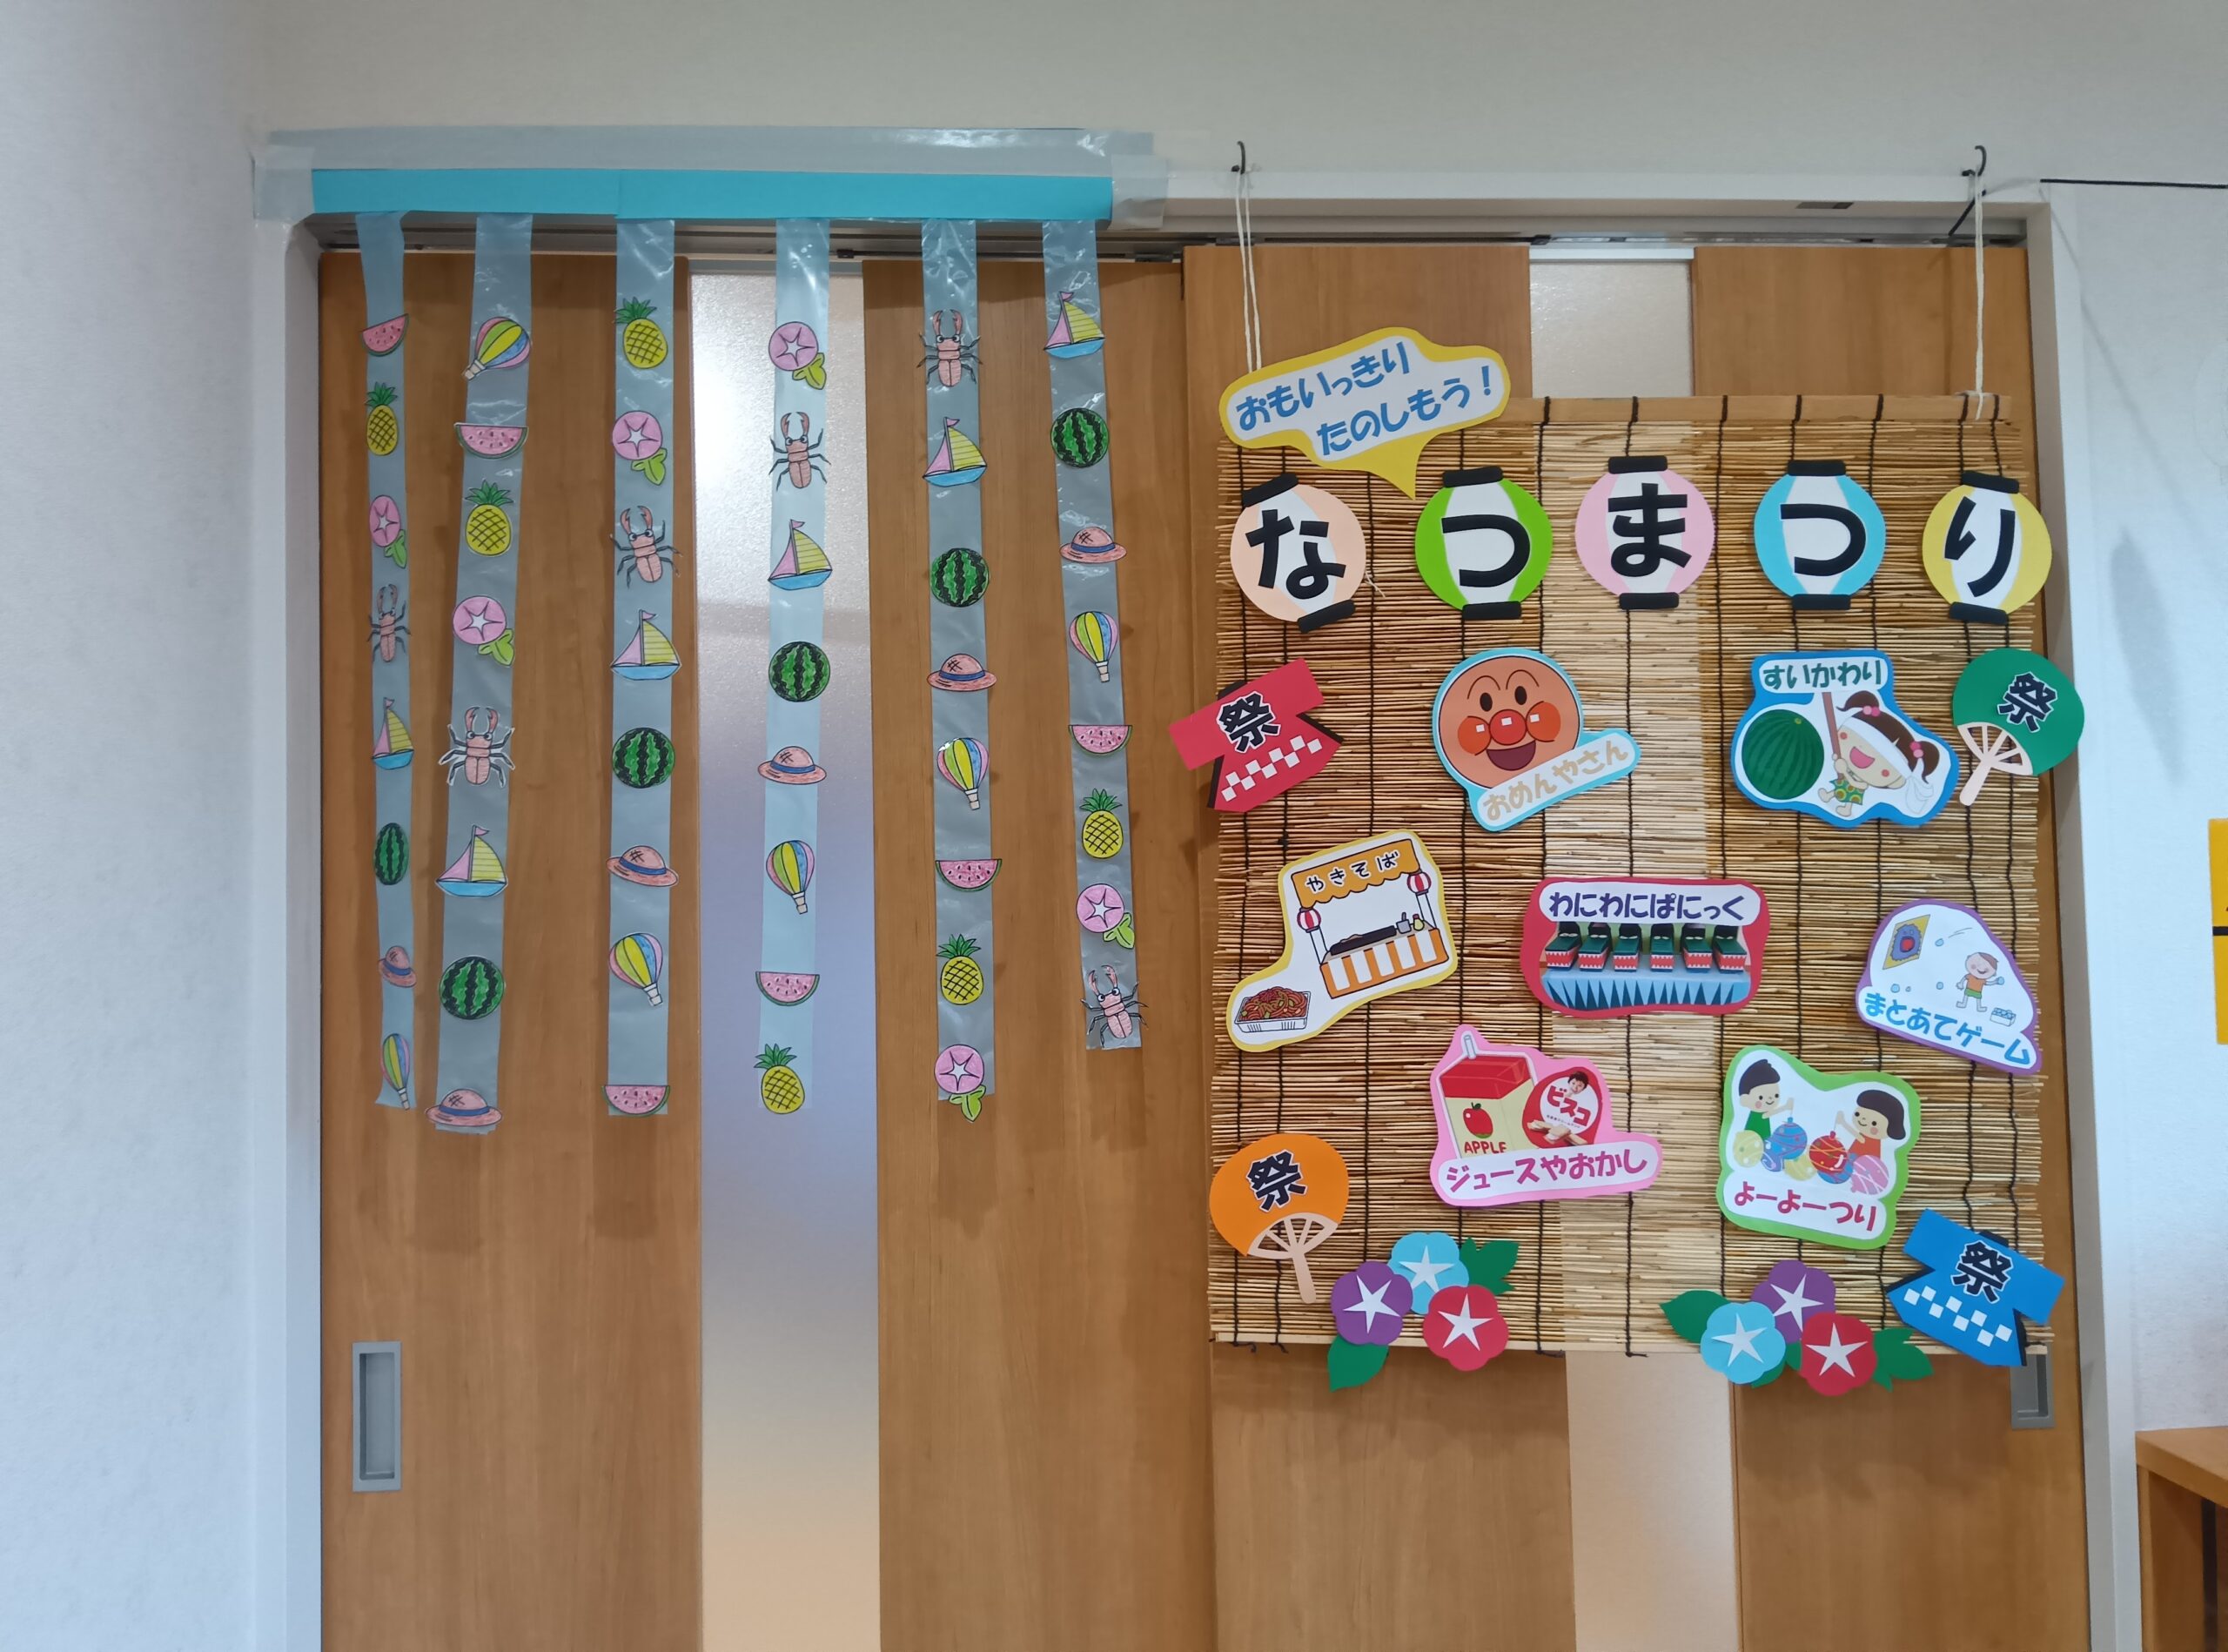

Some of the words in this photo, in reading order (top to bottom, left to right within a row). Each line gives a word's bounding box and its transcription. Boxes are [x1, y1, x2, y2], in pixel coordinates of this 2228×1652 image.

[1235, 341, 1410, 432] おもいっきり
[1763, 658, 1883, 690] すいかわり
[1996, 672, 2057, 732] 祭
[1218, 691, 1281, 753] 祭
[1482, 740, 1628, 821] おめんやさん
[1305, 850, 1399, 894] やきそば
[1548, 891, 1746, 922] わにわにぱにっく
[1863, 991, 2030, 1067] まとあてゲーム
[1547, 1085, 1592, 1126] ビスコ
[1446, 1149, 1648, 1193] ジュースやおかし
[1464, 1140, 1507, 1154] APPLE
[1246, 1150, 1308, 1213] 祭
[1733, 1179, 1877, 1232] よーよーつり
[1950, 1240, 2013, 1304] 祭
